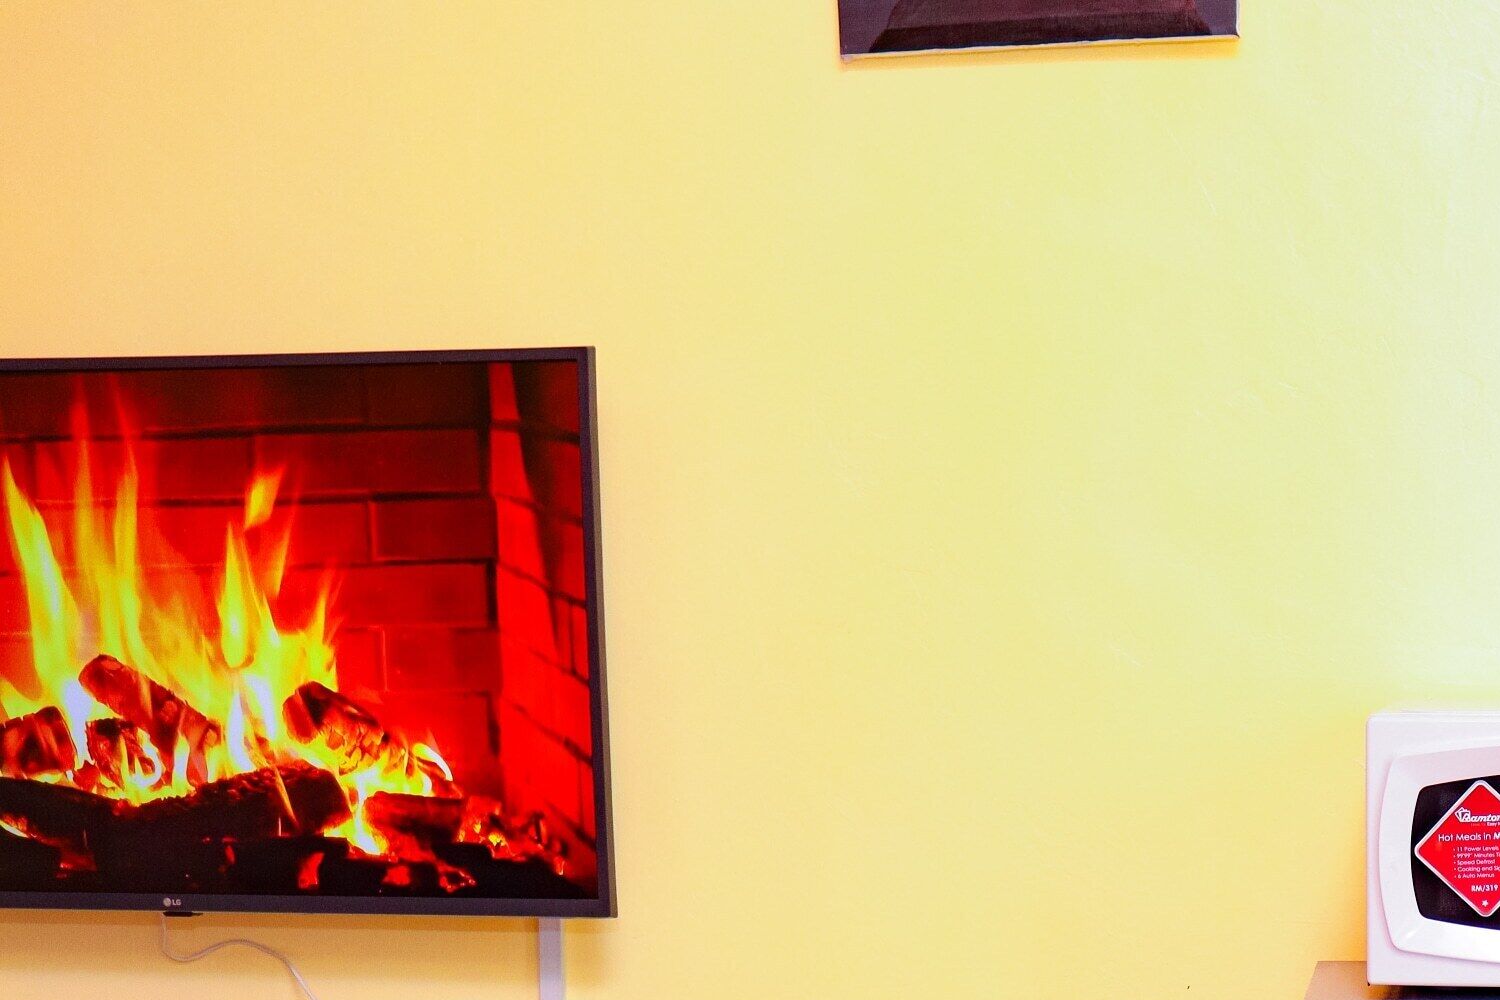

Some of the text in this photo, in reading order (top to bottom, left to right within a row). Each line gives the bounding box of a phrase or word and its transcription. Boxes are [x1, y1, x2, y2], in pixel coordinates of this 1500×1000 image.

[1438, 833, 1453, 841] Hot
[1456, 832, 1482, 841] Meals
[1484, 832, 1491, 840] in
[1471, 884, 1498, 892] RM/319
